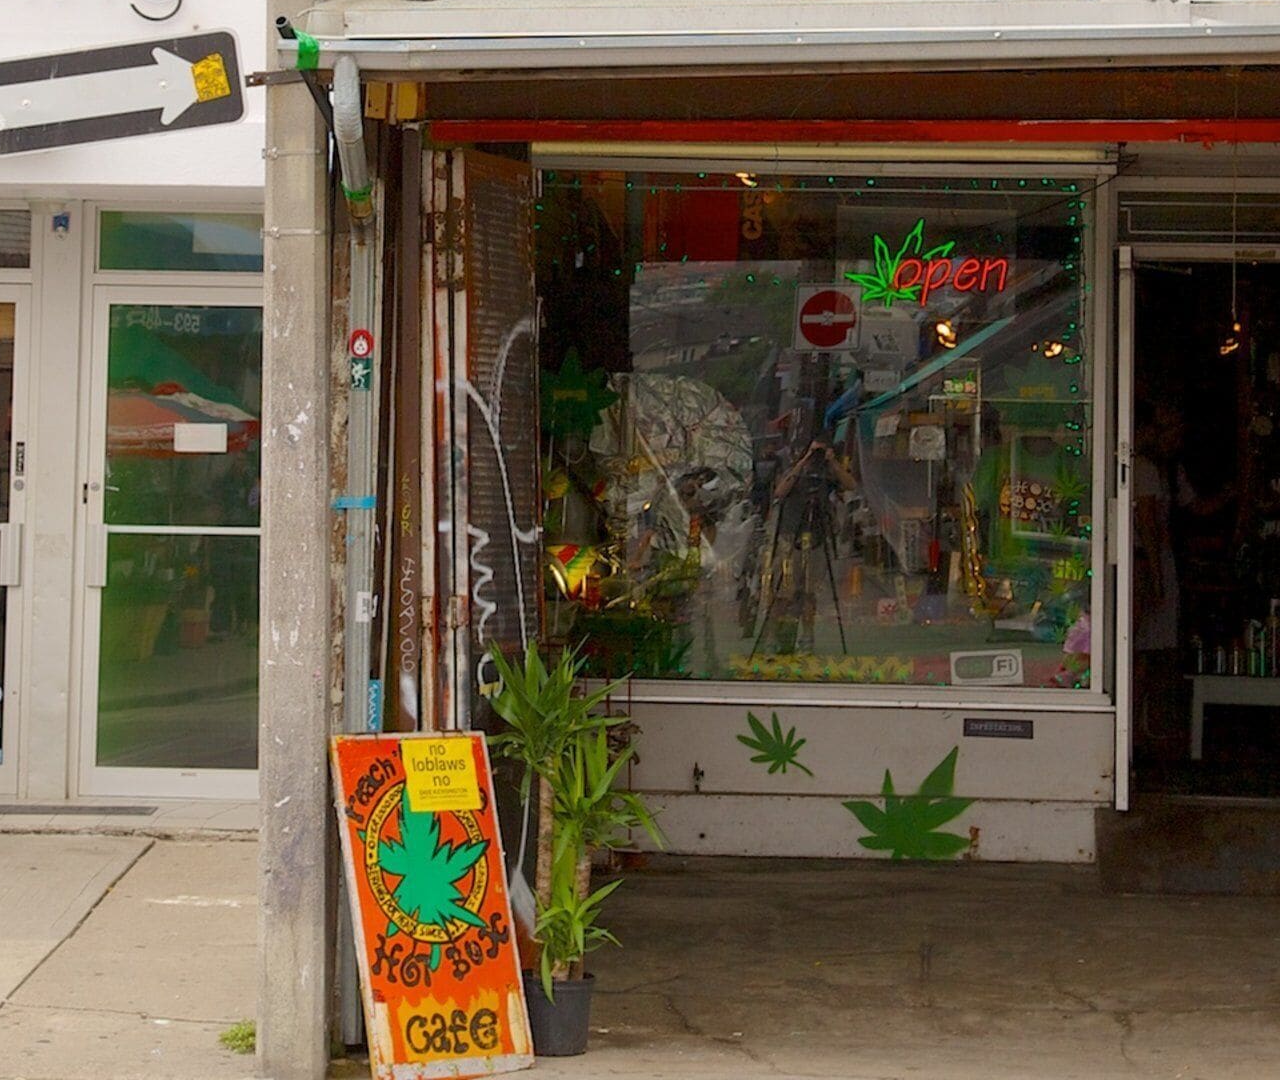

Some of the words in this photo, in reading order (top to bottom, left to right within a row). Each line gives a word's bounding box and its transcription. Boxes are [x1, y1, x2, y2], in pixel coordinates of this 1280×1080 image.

[893, 258, 1007, 307] open
[429, 743, 446, 756] no
[411, 756, 467, 772] loblaws
[432, 772, 451, 787] no
